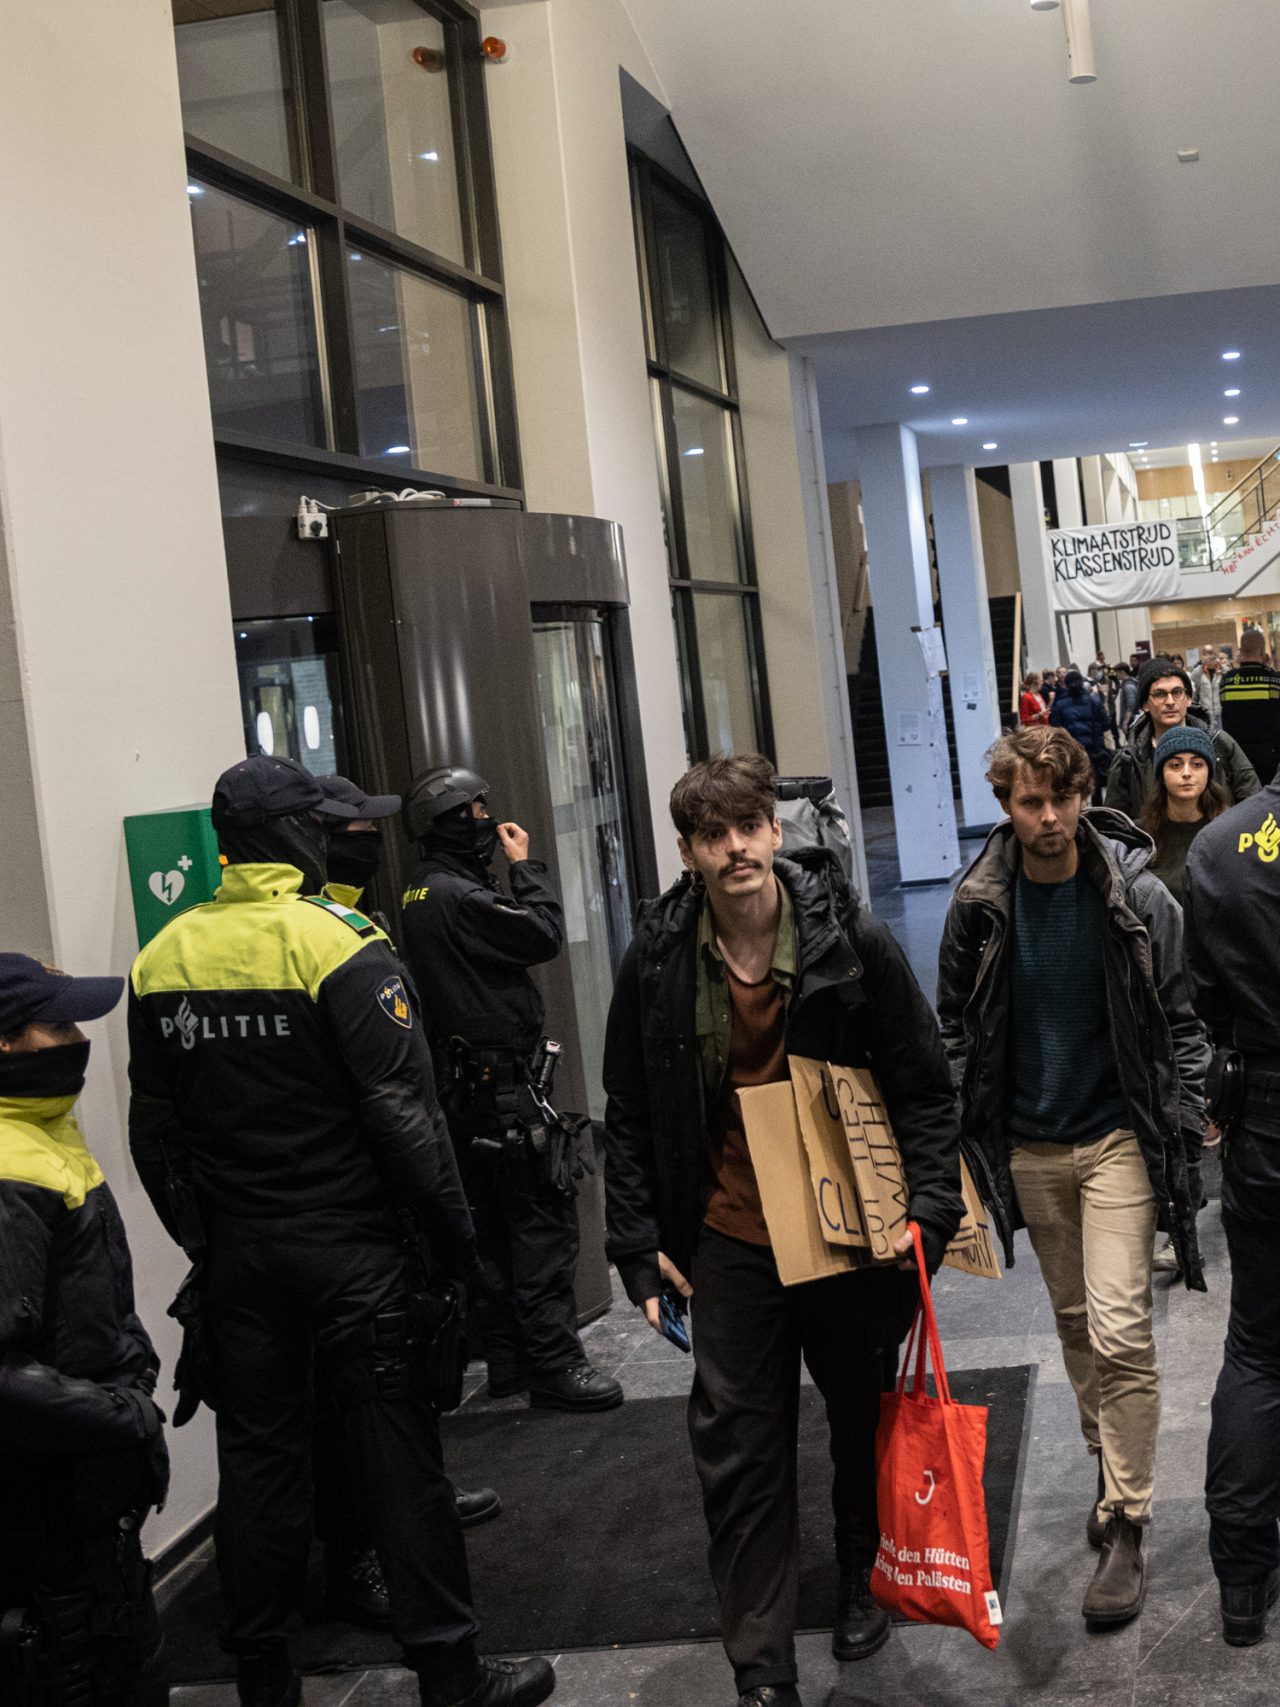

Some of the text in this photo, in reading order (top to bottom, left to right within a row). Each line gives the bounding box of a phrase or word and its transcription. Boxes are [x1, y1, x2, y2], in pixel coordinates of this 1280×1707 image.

[160, 995, 291, 1050] POLITIE
[898, 1546, 920, 1563] den
[924, 1547, 970, 1571] Hütten
[916, 1569, 972, 1595] Palästen
